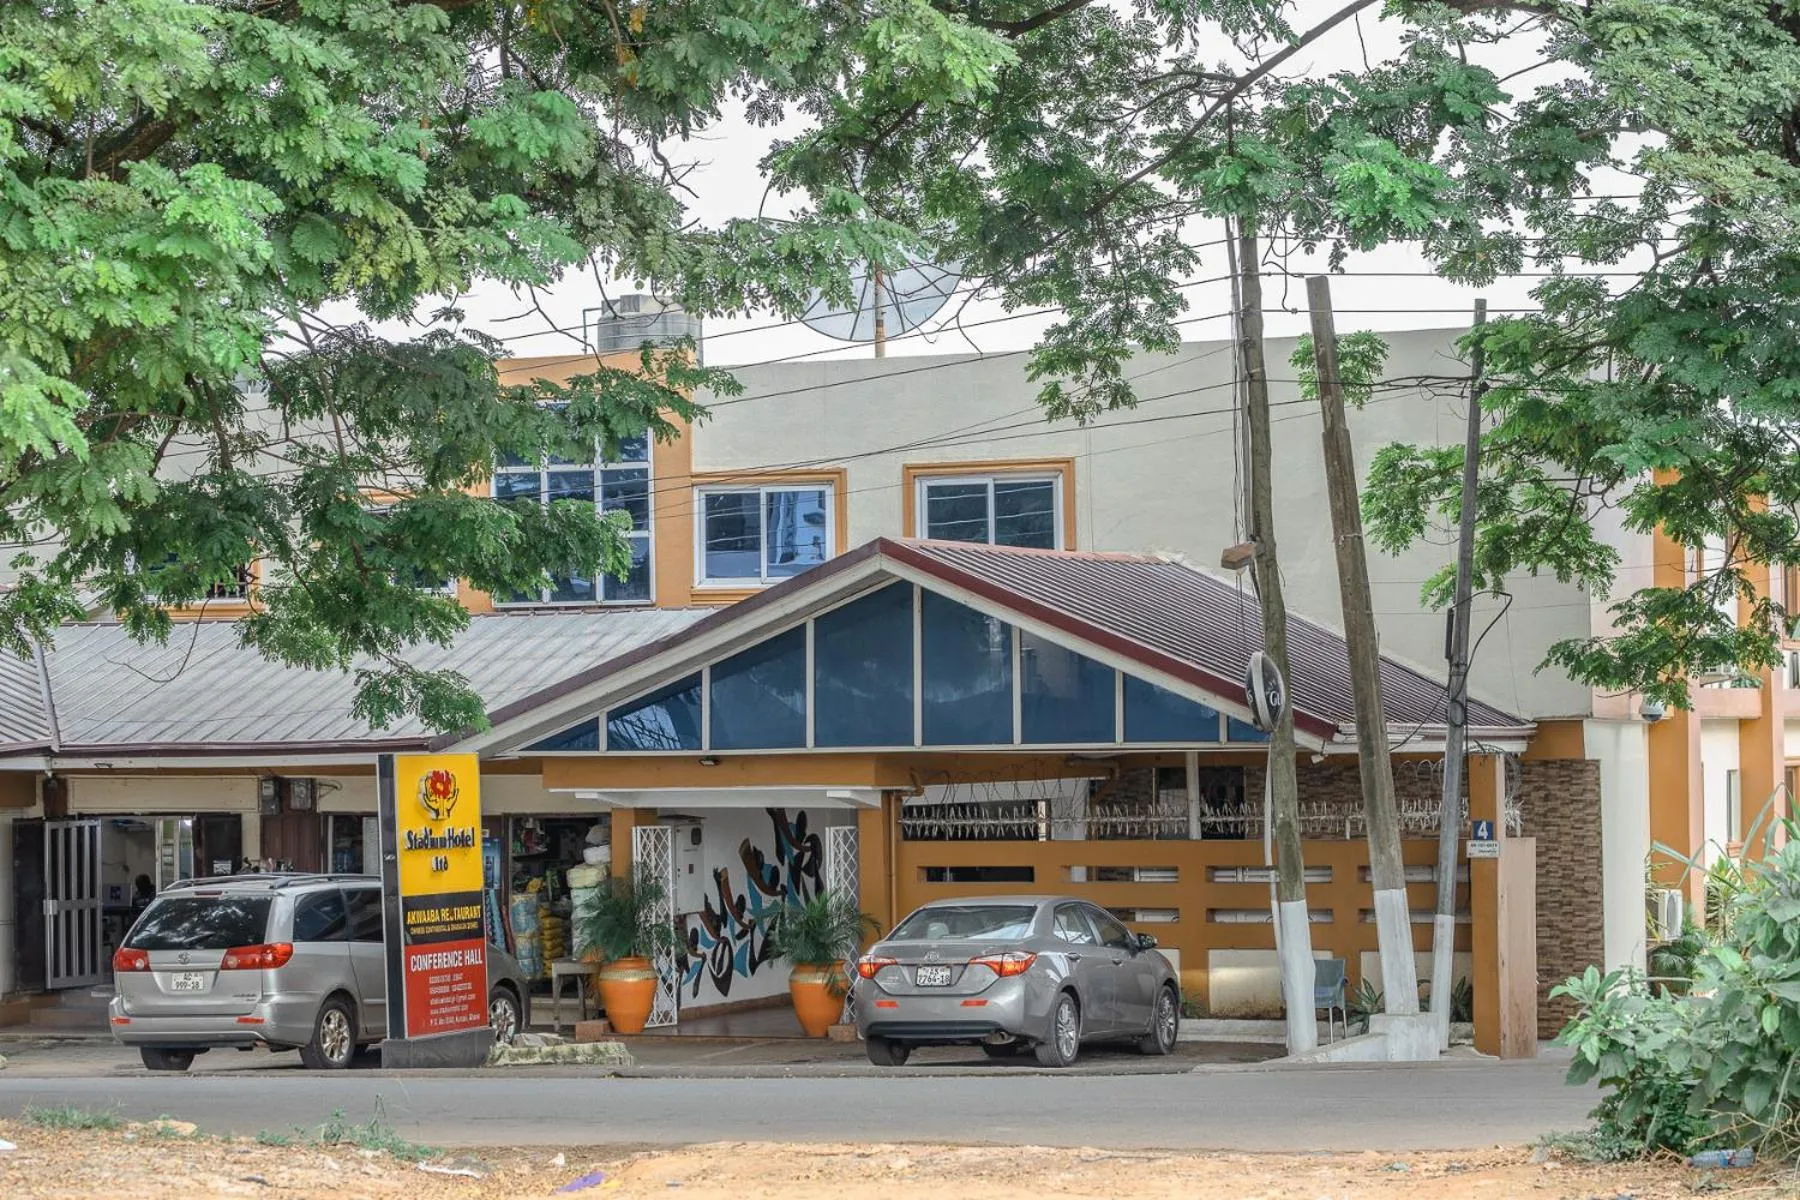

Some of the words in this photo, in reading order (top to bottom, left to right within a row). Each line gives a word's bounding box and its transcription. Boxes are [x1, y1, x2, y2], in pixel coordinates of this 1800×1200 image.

[405, 827, 446, 850] Stadium
[446, 827, 475, 848] Hotel
[1477, 820, 1489, 840] 4
[407, 909, 440, 925] AKWAABA
[411, 950, 463, 972] CONFERENCE
[464, 948, 483, 966] HALL
